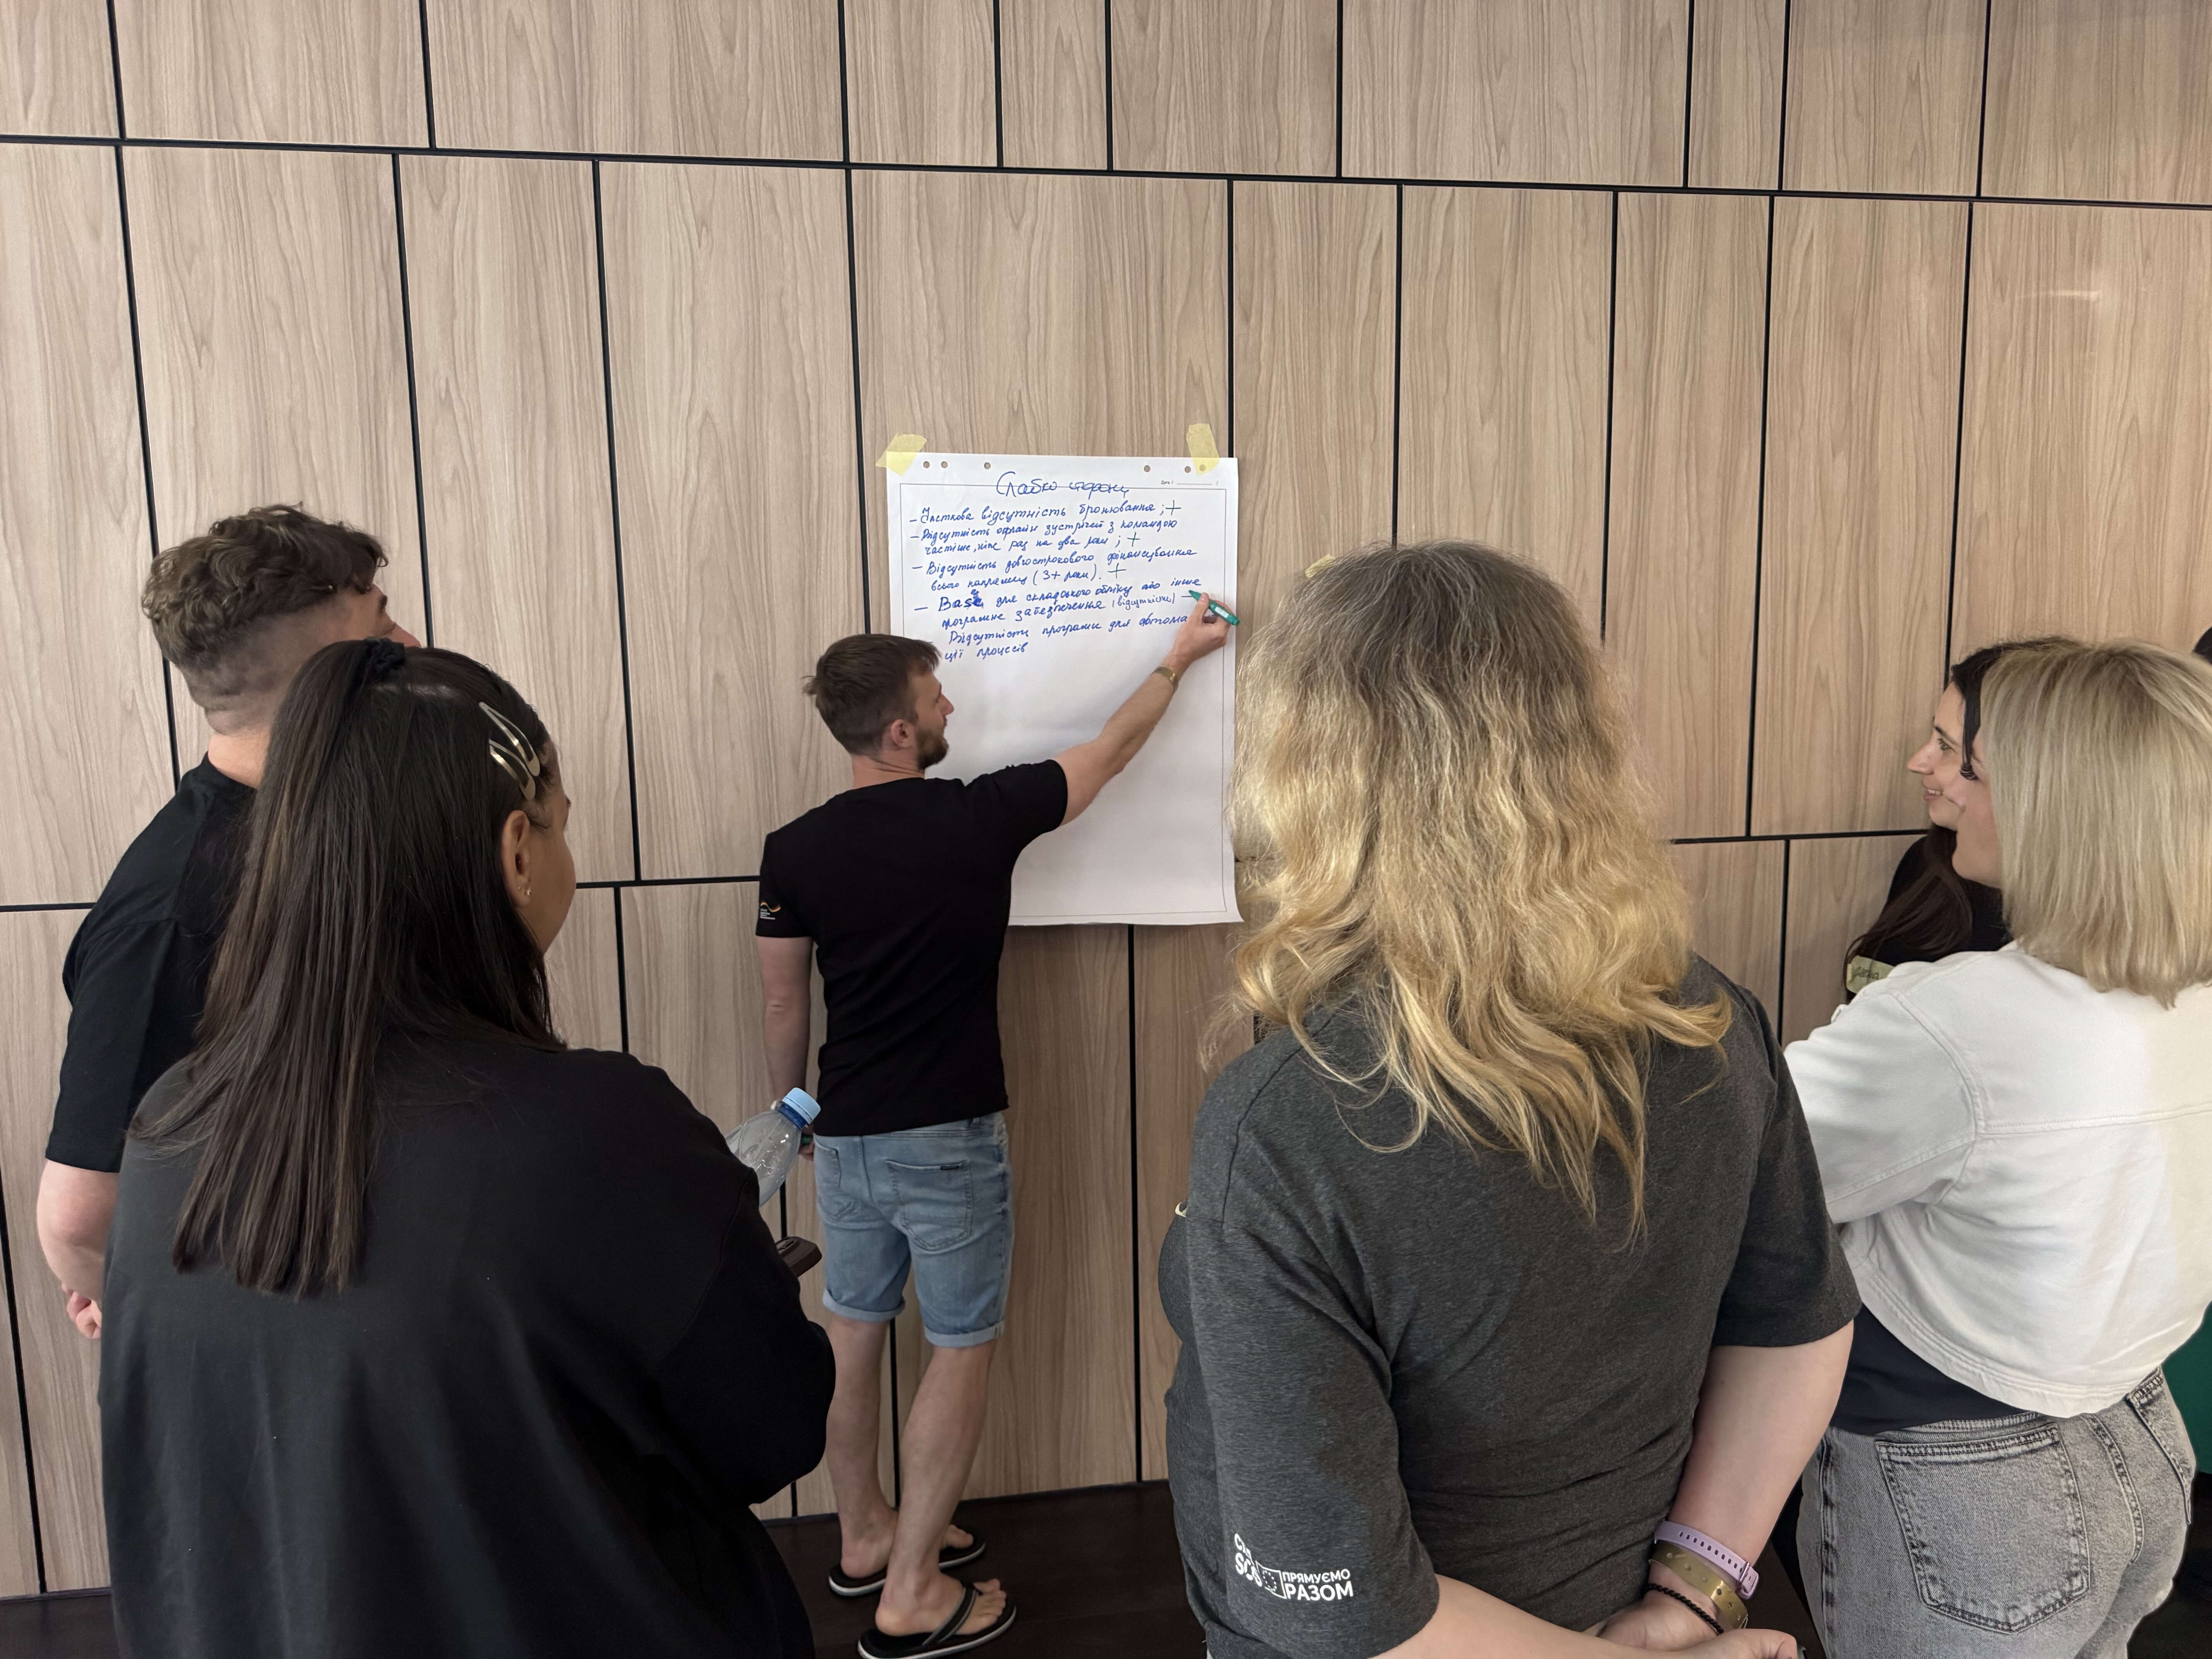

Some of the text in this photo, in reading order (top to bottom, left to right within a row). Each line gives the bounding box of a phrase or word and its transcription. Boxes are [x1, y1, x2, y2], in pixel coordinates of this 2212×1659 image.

[1108, 521, 1114, 534] з
[1057, 535, 1081, 550] два
[1282, 1568, 1351, 1584] ПРЯМУЄМО
[1285, 1580, 1354, 1601] РАЗОМ
